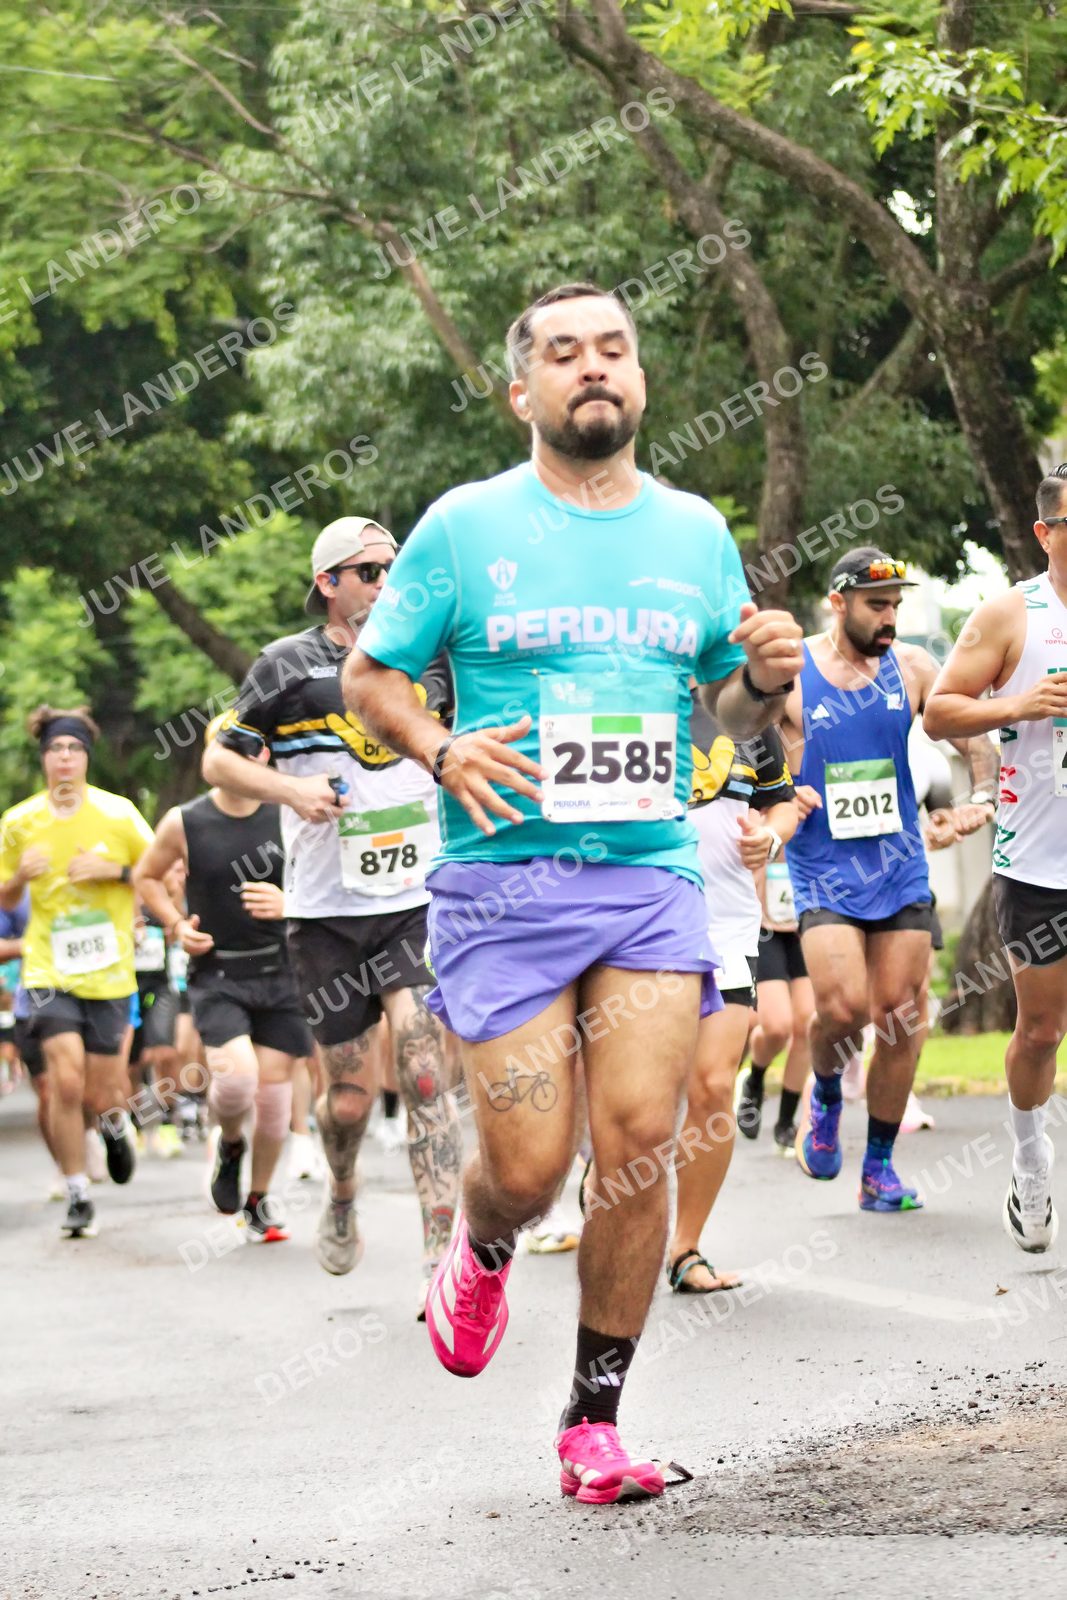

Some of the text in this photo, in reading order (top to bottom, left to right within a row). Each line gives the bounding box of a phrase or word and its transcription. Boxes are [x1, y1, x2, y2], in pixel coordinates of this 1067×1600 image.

[486, 606, 698, 658] PERDURA
[552, 740, 672, 785] 2585
[553, 800, 591, 808] PERDURA
[834, 793, 893, 819] 2012
[360, 844, 418, 876] 878
